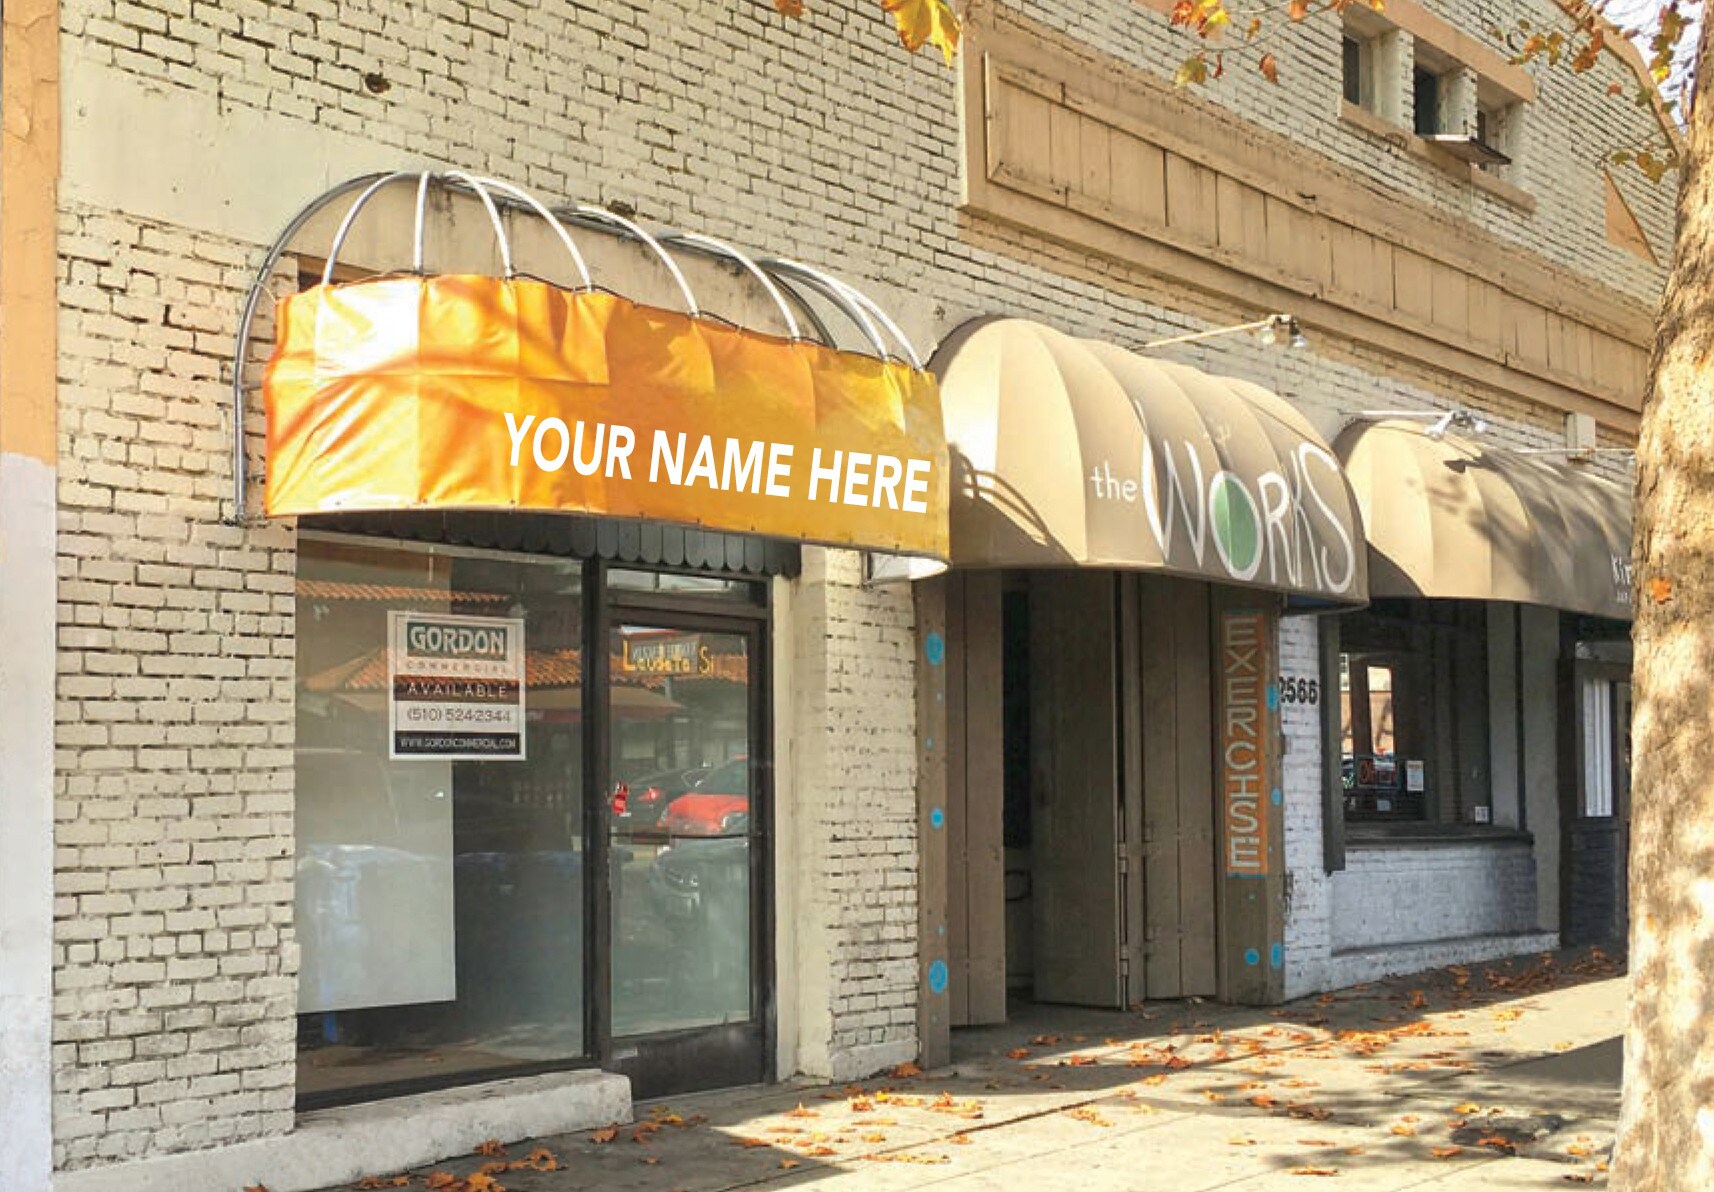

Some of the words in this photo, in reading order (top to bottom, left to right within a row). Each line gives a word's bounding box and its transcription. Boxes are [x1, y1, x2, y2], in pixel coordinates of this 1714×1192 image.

[503, 412, 636, 480] YOUR
[648, 429, 795, 498] NAME
[807, 447, 932, 514] HERE
[1090, 459, 1138, 501] the
[1133, 400, 1355, 594] WORKS
[410, 625, 505, 657] GORDON
[406, 660, 507, 674] COMMERCIAL
[407, 681, 508, 698] AVAILABLE
[1279, 676, 1318, 705] 2566
[407, 707, 442, 722] (510)
[1225, 617, 1260, 868] EXERCISE
